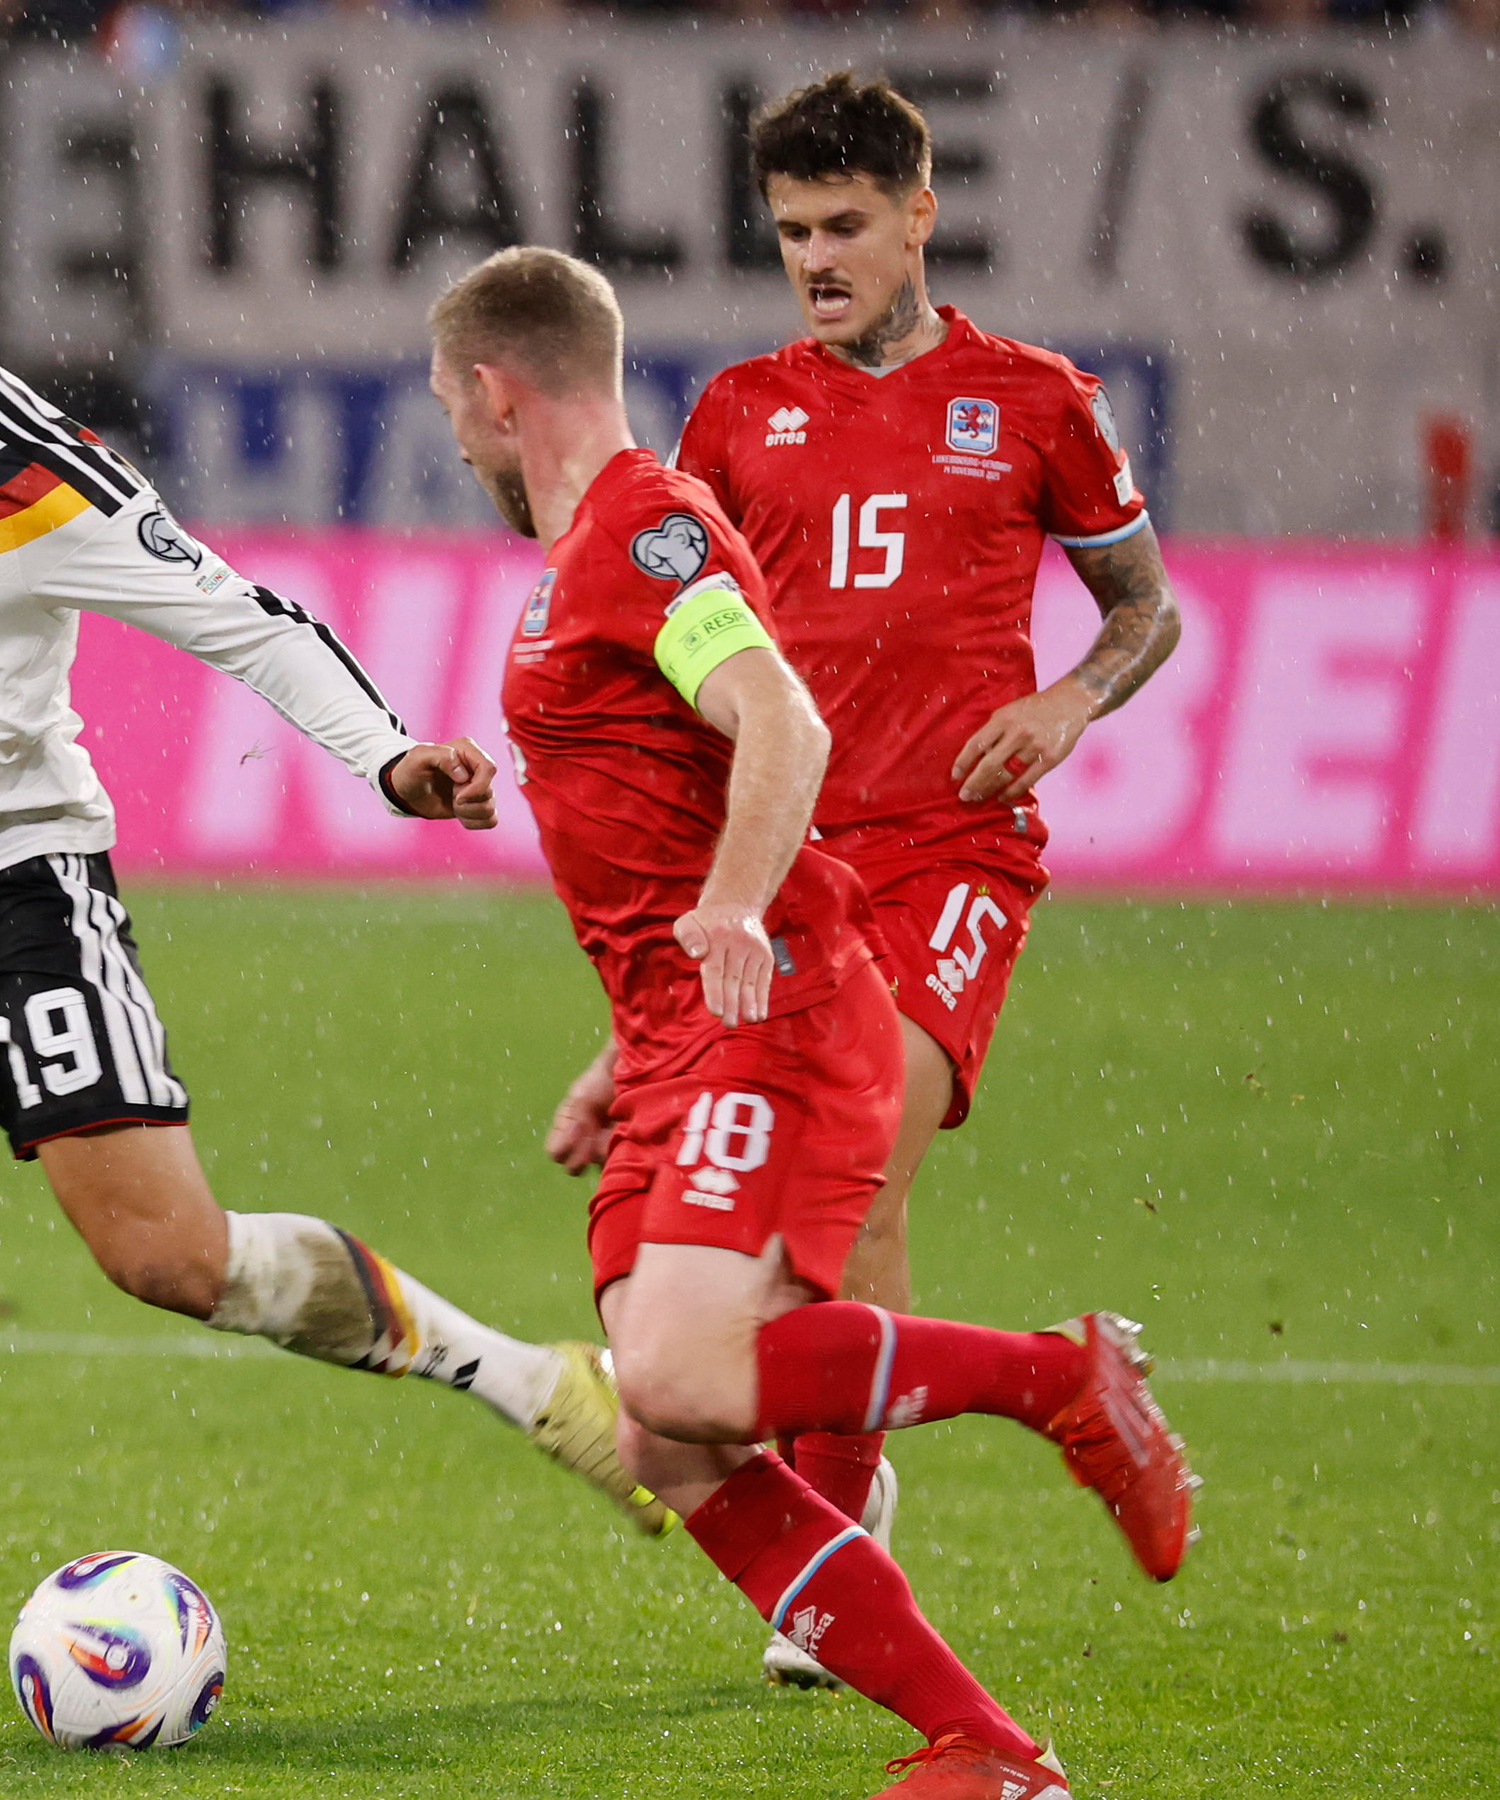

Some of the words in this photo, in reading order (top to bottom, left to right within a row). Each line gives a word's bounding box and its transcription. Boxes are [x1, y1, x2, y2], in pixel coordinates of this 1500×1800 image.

[829, 493, 908, 589] 15
[928, 882, 1008, 980] 15
[675, 1090, 776, 1173] 18
